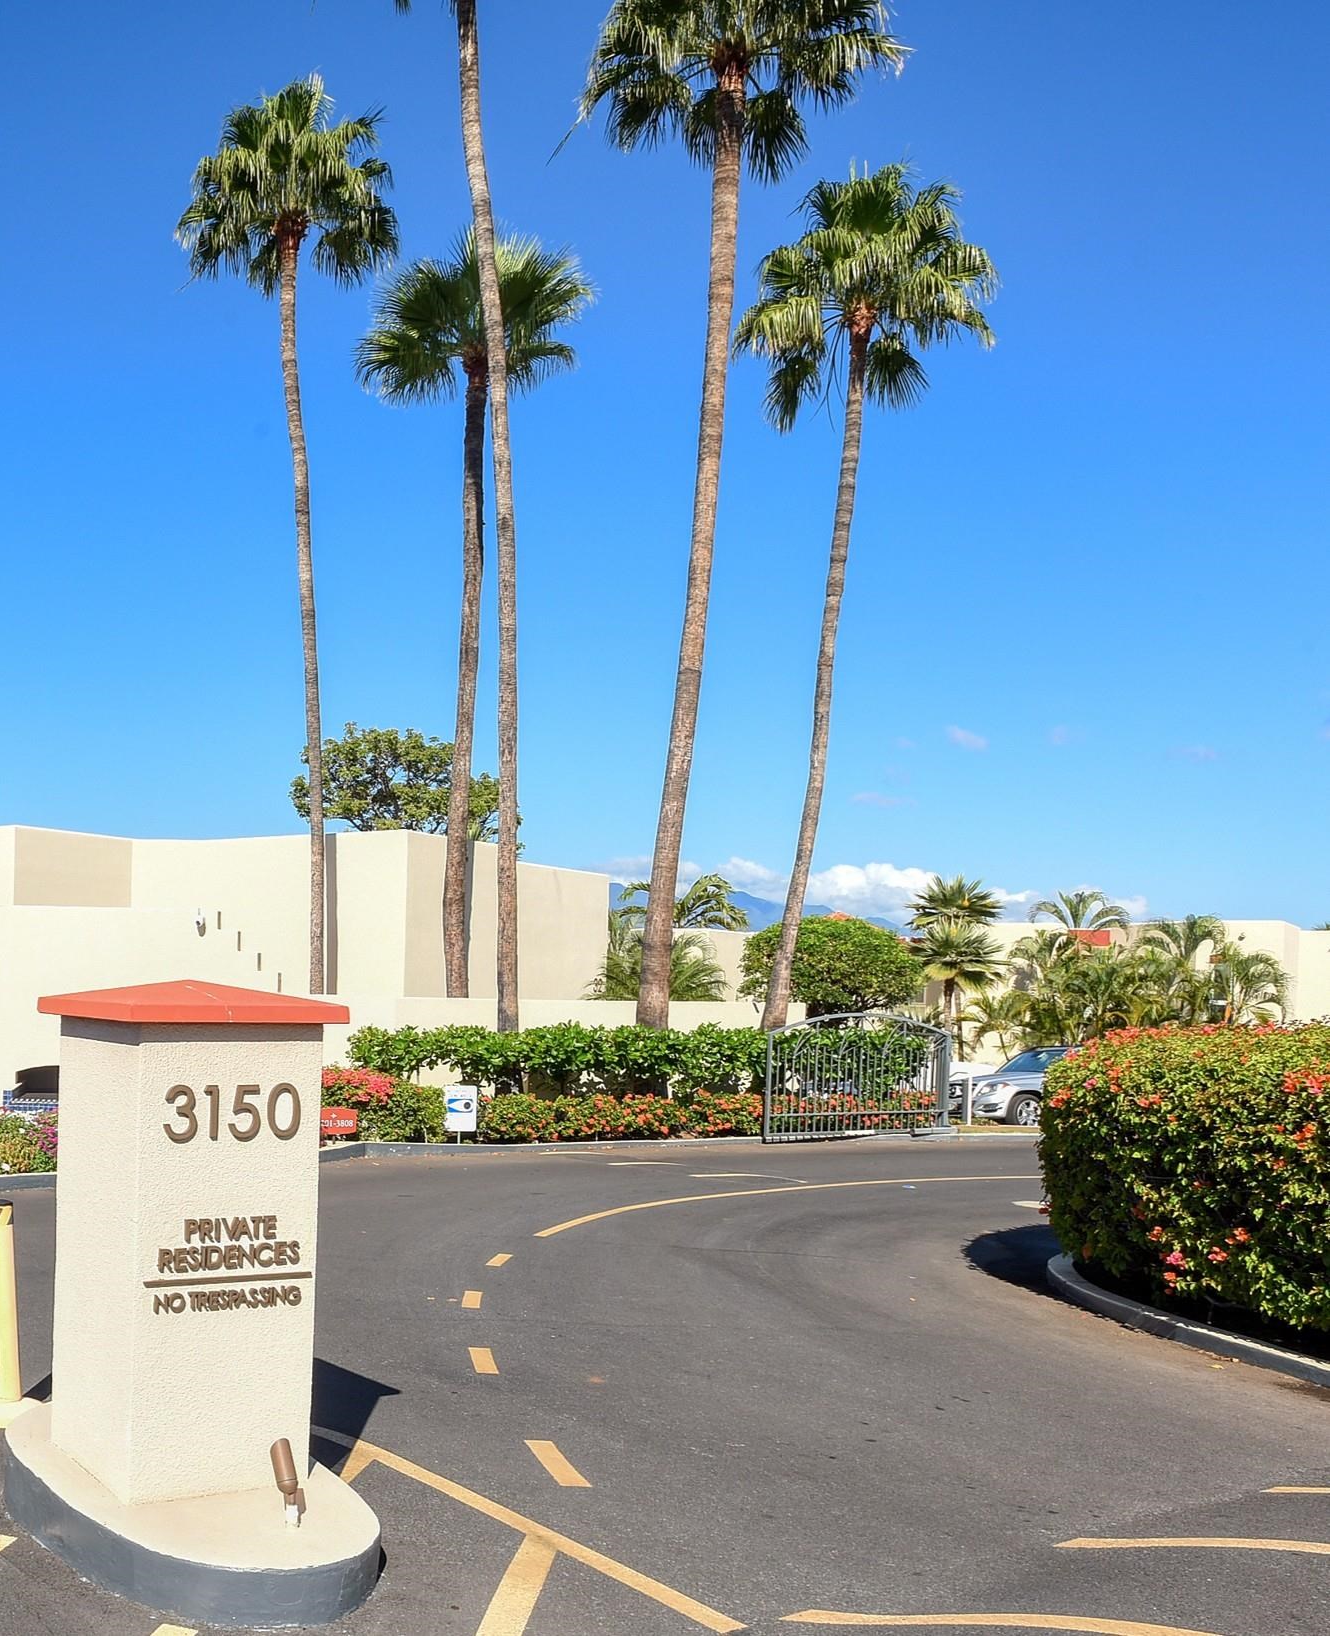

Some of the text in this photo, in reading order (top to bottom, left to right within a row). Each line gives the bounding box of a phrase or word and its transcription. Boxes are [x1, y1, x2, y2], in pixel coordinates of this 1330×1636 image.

[163, 1083, 301, 1143] 3150
[184, 1215, 277, 1243] PRIVATE
[158, 1240, 300, 1273] RESIDENCES
[153, 1285, 302, 1315] NO TRESPASSING
